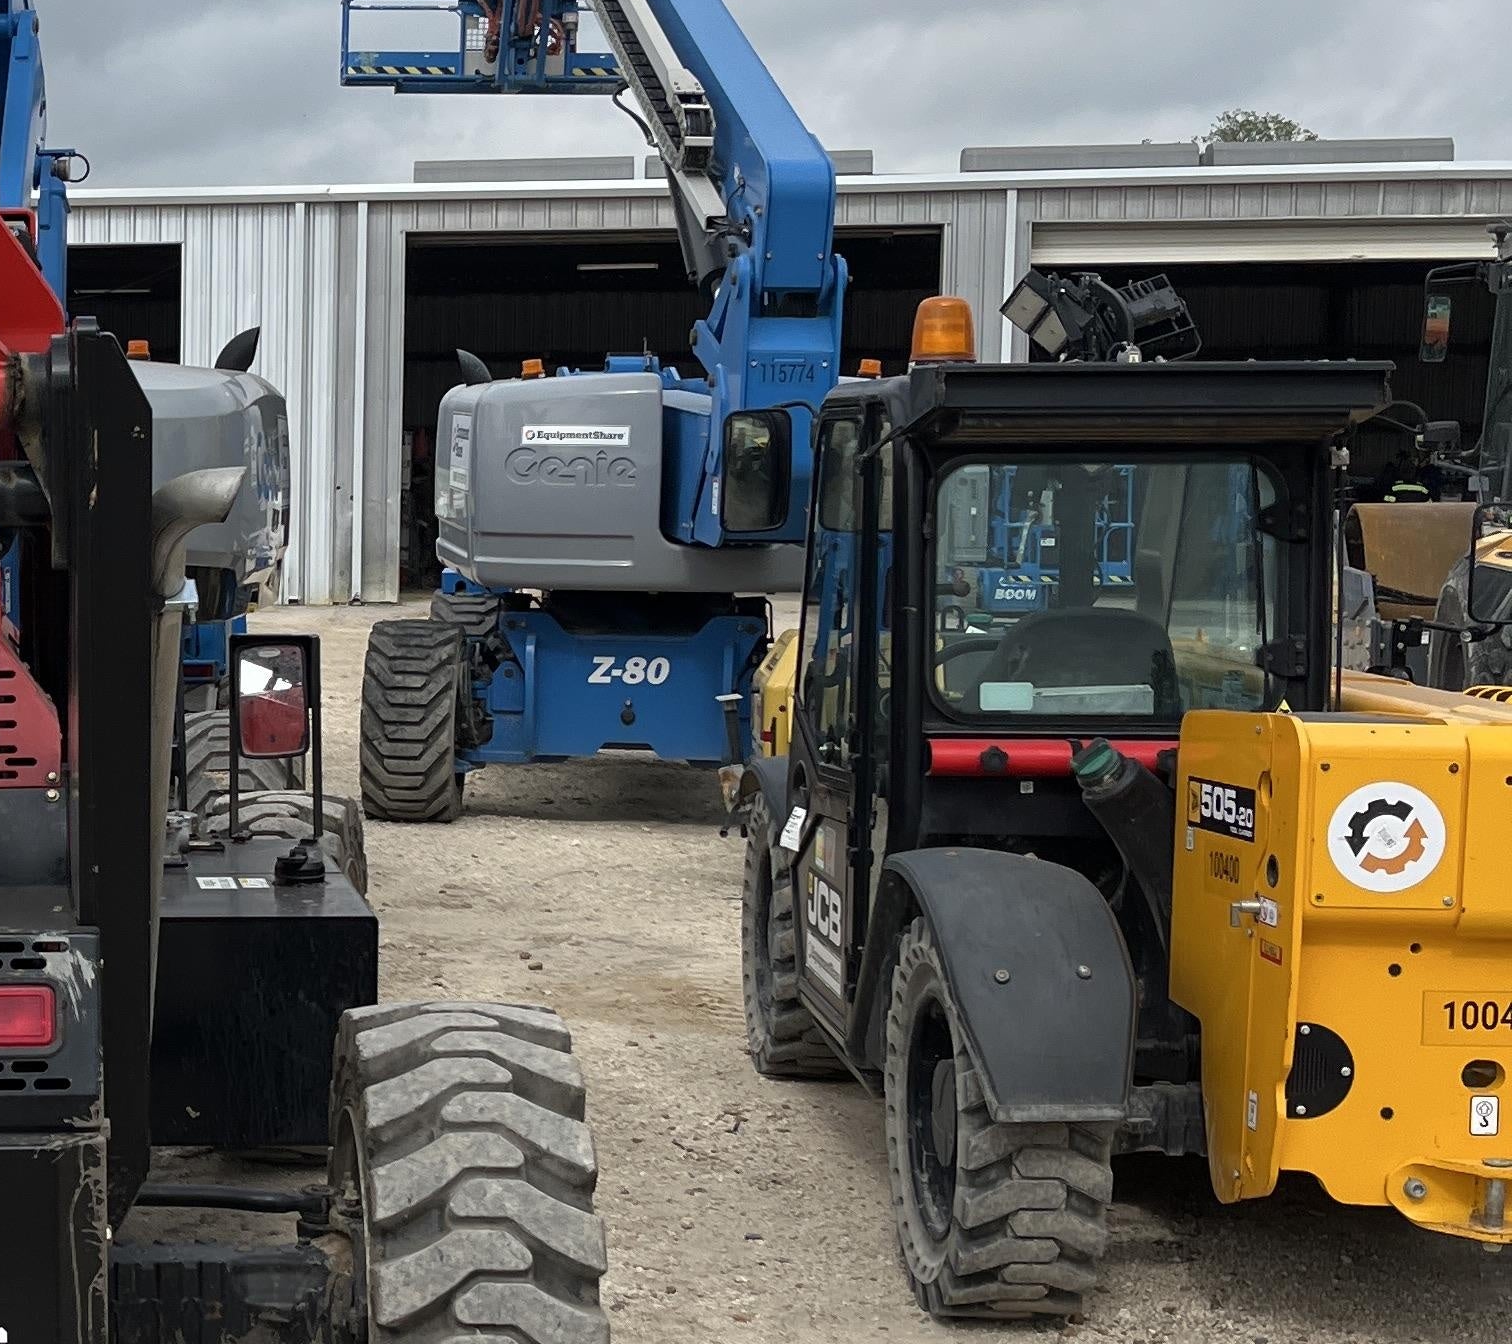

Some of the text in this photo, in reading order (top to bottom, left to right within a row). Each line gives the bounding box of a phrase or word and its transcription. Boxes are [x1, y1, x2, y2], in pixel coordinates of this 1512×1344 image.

[759, 363, 815, 384] 115774
[536, 429, 625, 442] EquipmentShare
[505, 447, 637, 487] Genie
[994, 588, 1037, 601] BOOM
[587, 656, 671, 685] Z-80
[807, 873, 842, 947] JCB
